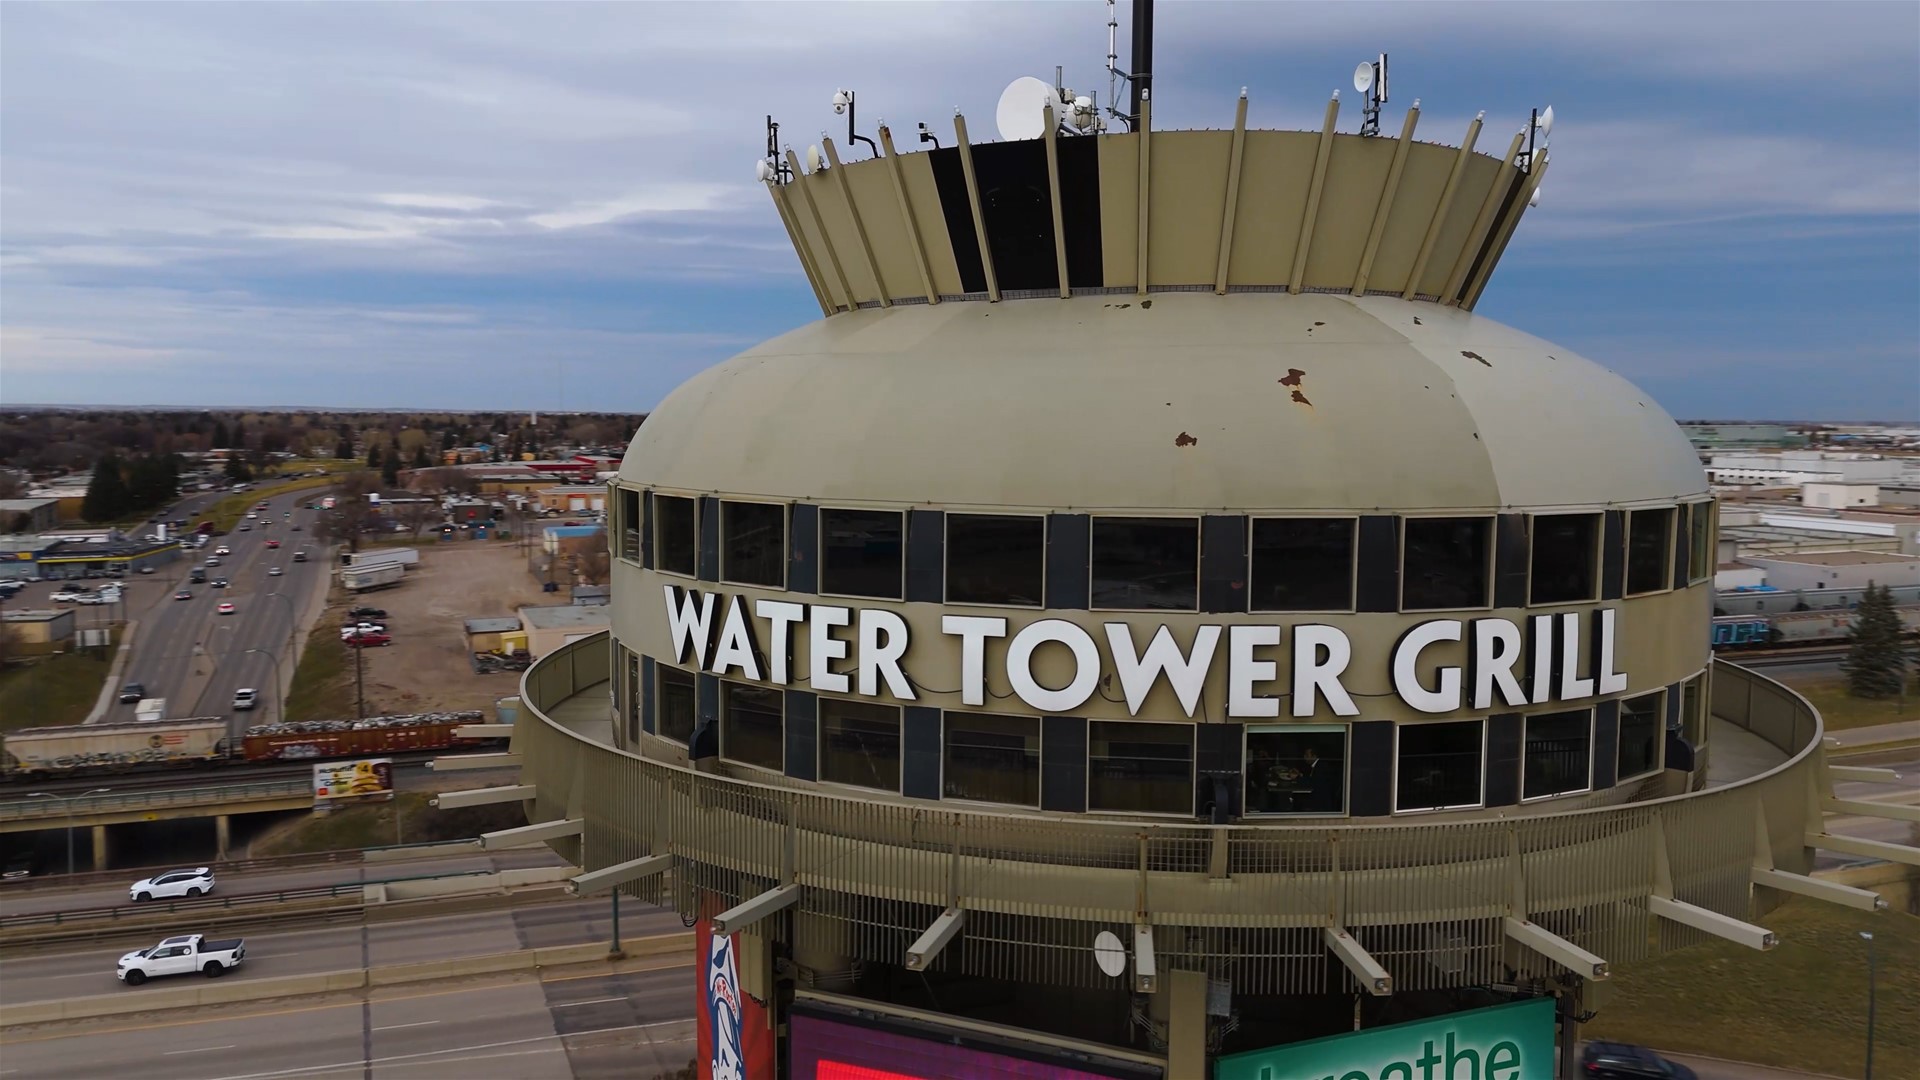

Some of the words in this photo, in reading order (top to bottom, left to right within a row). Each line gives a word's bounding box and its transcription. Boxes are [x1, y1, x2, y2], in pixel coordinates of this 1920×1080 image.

[663, 584, 917, 700] WATER
[941, 614, 1361, 718] TOWER
[1390, 608, 1627, 713] GRILL
